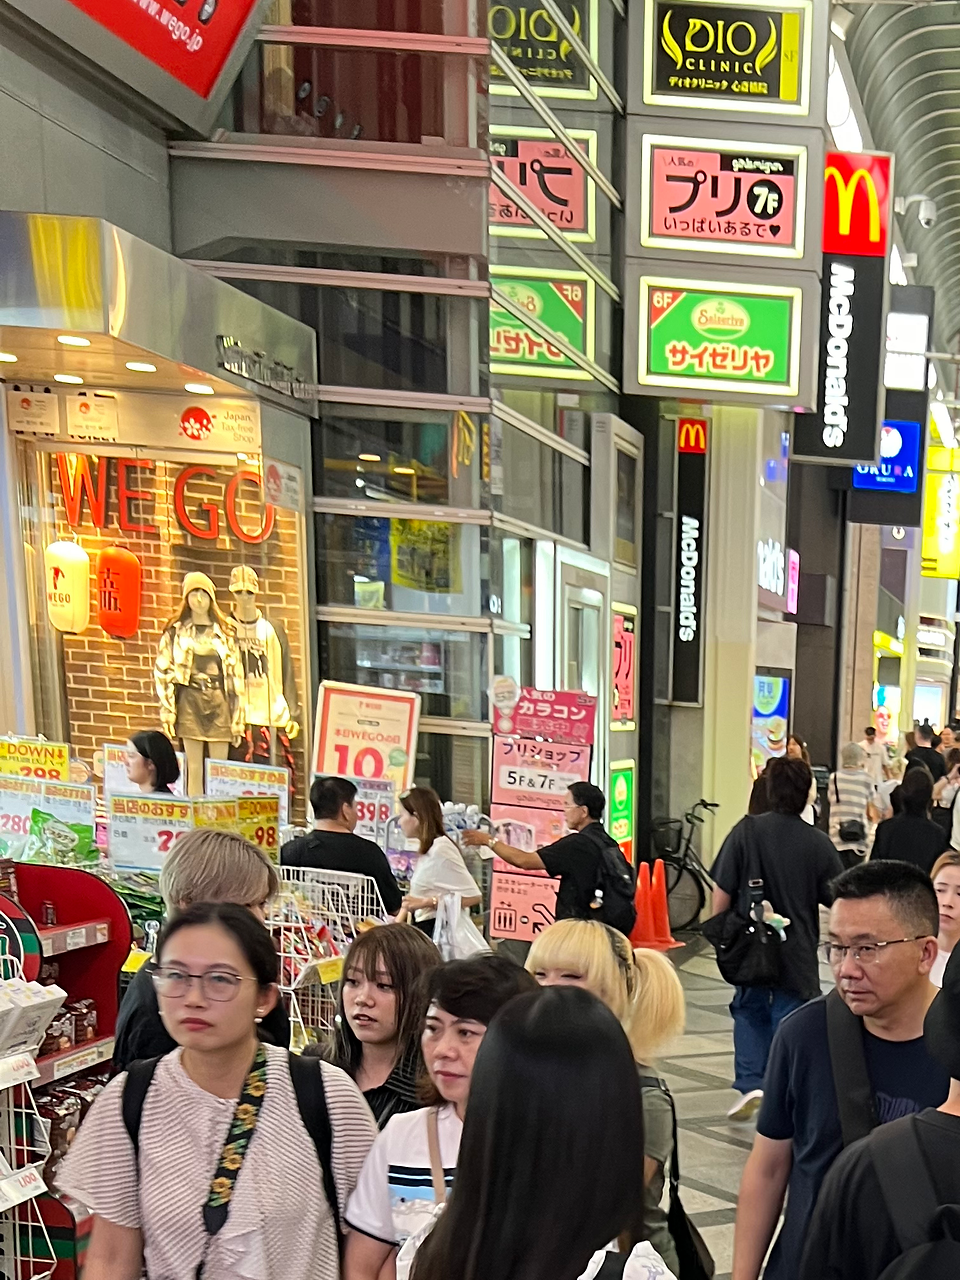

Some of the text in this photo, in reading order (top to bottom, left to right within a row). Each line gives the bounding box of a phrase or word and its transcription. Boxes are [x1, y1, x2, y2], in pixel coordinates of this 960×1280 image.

[685, 17, 757, 57] DIO
[685, 57, 754, 74] CLINIC
[665, 170, 742, 218] プリ
[752, 185, 779, 215] 7F
[663, 216, 767, 239] いっぱいあるで
[652, 292, 674, 309] 6F
[668, 343, 772, 373] サイゼリヤ
[822, 261, 855, 450] McDonald's
[55, 451, 275, 544] WEGO
[678, 514, 701, 643] McDonald's
[518, 702, 587, 720] カラコン
[7, 743, 55, 760] DOWN
